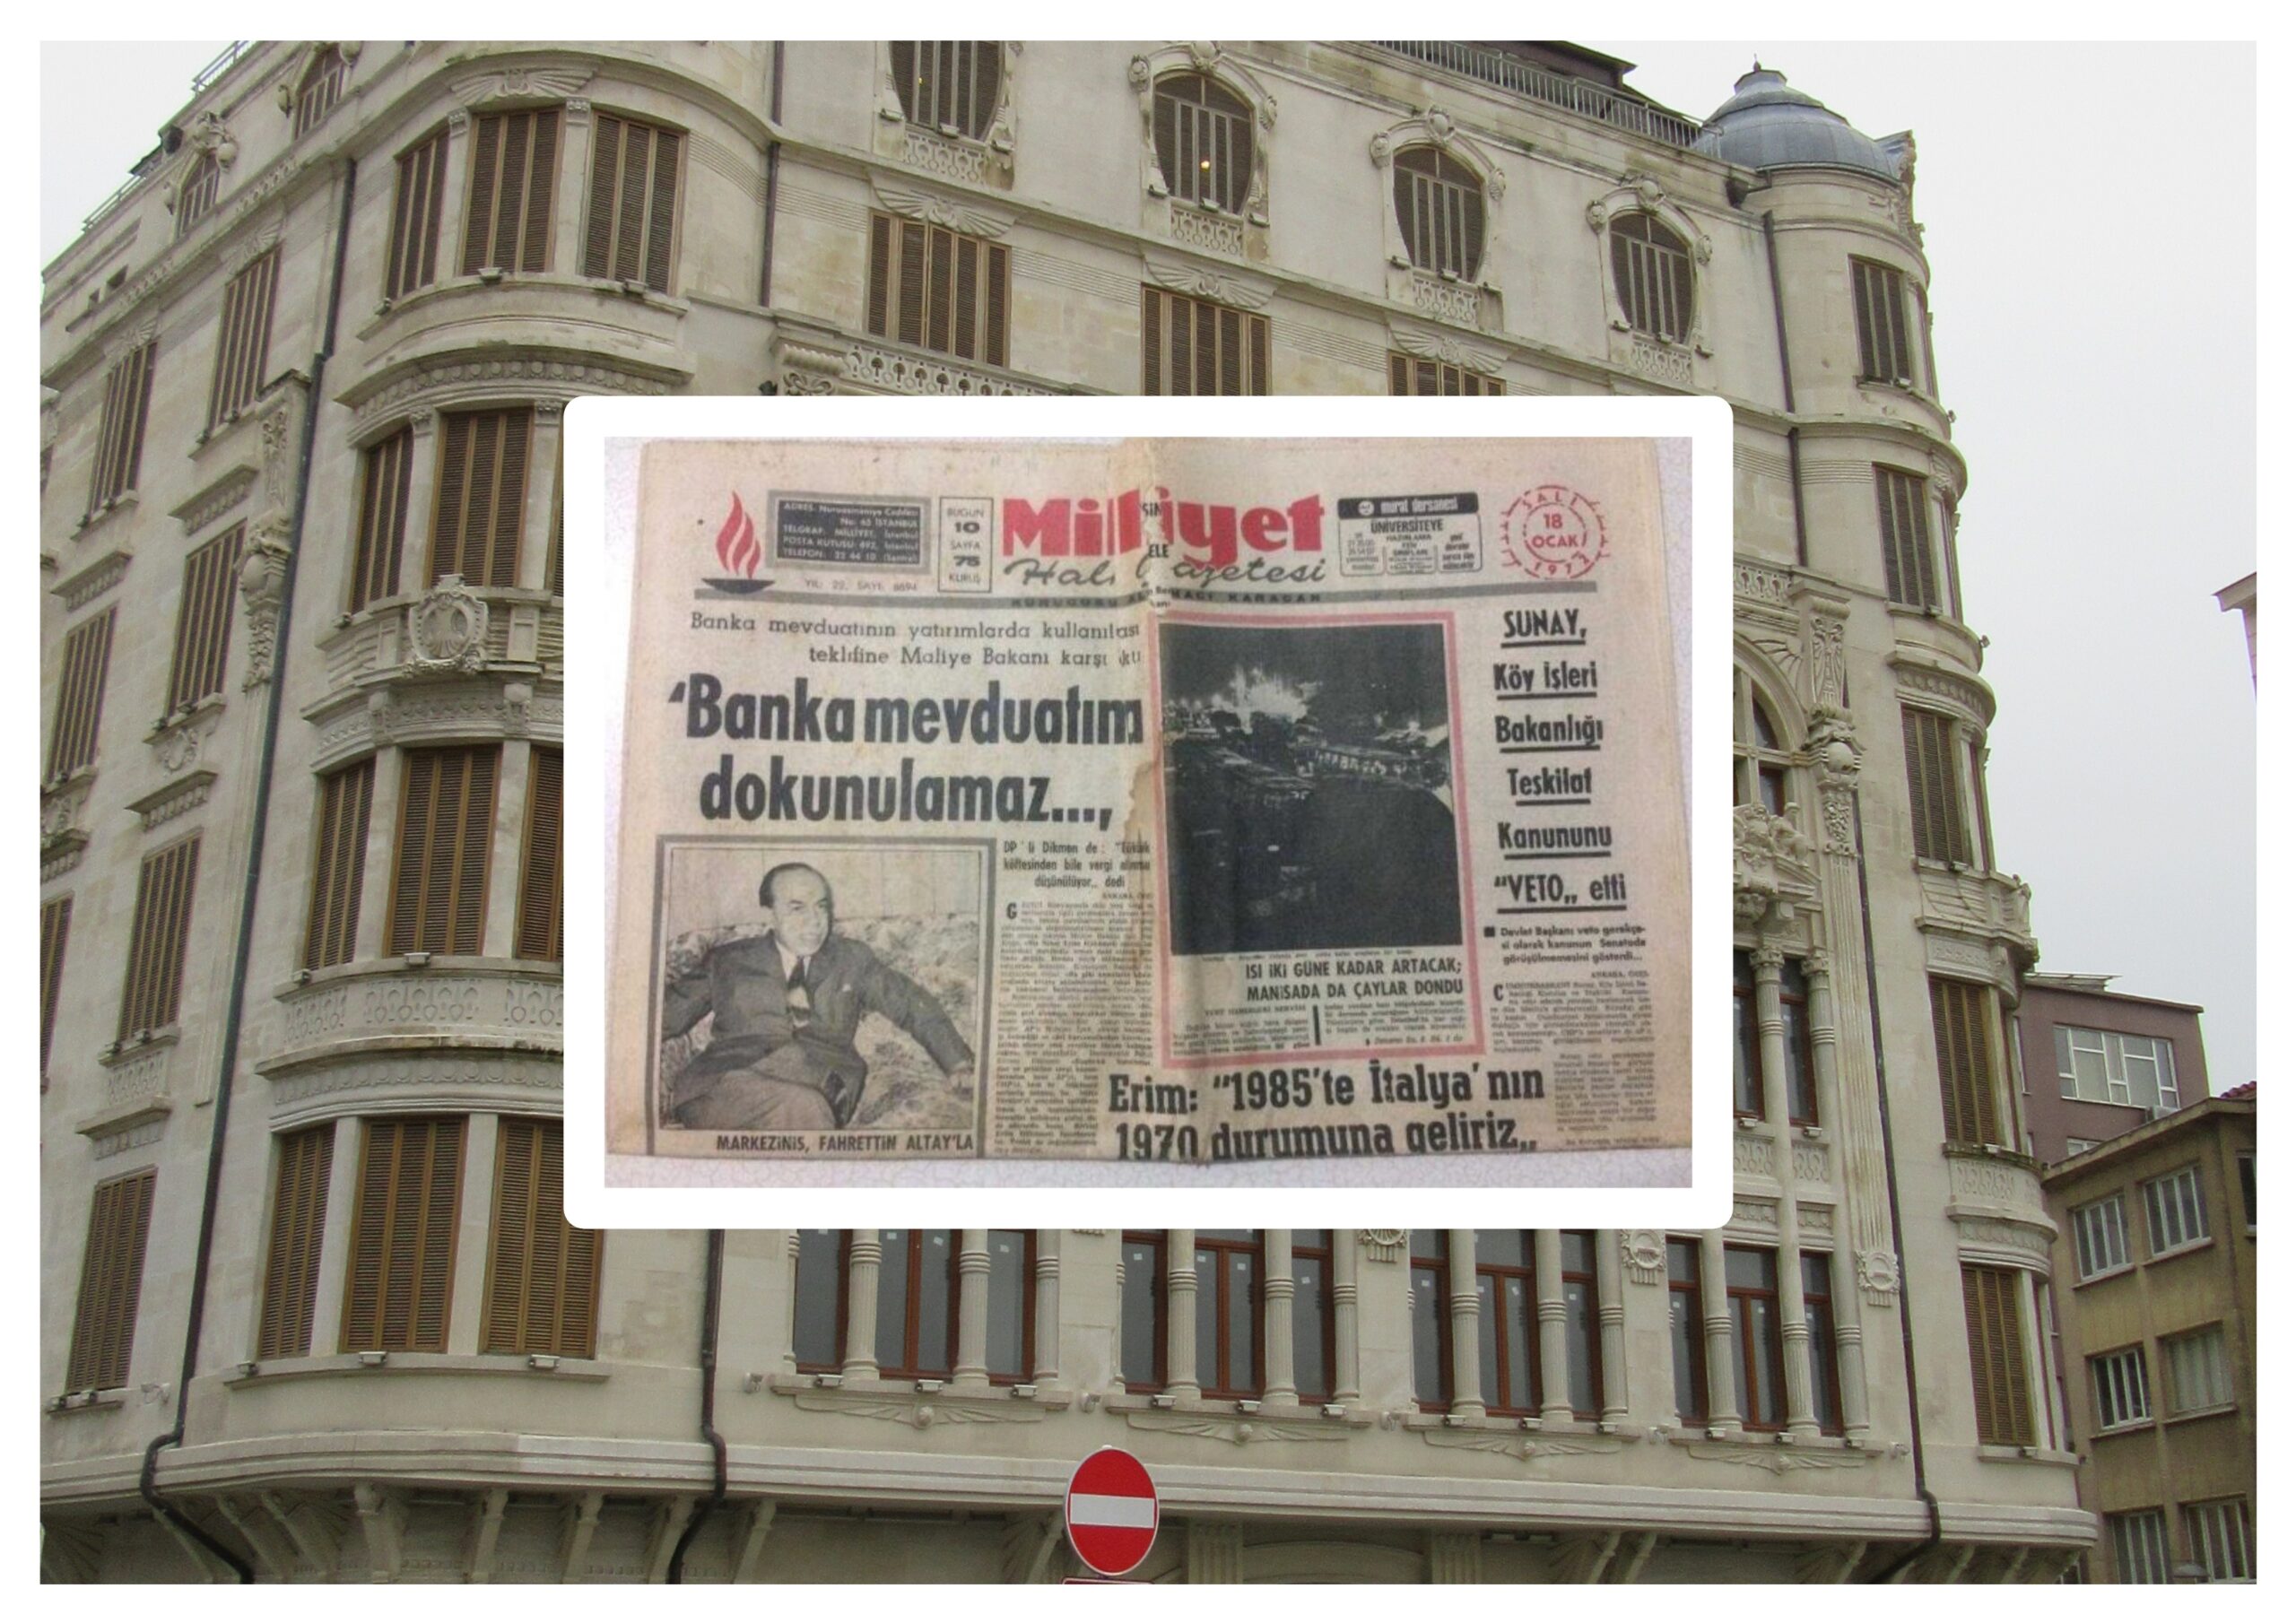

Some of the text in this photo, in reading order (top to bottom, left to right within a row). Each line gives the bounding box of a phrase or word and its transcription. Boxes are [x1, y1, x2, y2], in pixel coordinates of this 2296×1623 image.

[954, 522, 980, 534] 10
[1543, 513, 1563, 529] 18
[950, 542, 981, 551] SAYFA
[1531, 534, 1578, 549] OCAK
[953, 555, 981, 567] 75
[690, 612, 755, 633] Banka
[769, 618, 896, 638] mevduatının
[908, 621, 1031, 642] yatırımlarda
[1503, 607, 1587, 639] SUNAY,
[900, 647, 973, 670] Maliye
[982, 648, 1050, 666] Bakanı
[1493, 663, 1535, 691] Köy
[1495, 714, 1604, 746] Bakanlığı
[1497, 821, 1613, 849] Kanununu
[1064, 858, 1083, 870] bile
[1589, 872, 1628, 901] etti
[1500, 925, 1533, 936] Devlet
[1577, 925, 1600, 935] veto
[1547, 939, 1593, 950] kanunun
[1246, 963, 1263, 979] ISI
[1293, 959, 1331, 977] GÜNE
[1336, 959, 1385, 976] KADAR
[1391, 957, 1462, 974] ARTACAK;
[1327, 981, 1346, 999] DA
[1353, 979, 1407, 1000] ÇAYLAR
[1414, 977, 1464, 995] DONDU
[1108, 1072, 1198, 1115] Erim:
[818, 1134, 897, 1151] FAHRETTİN
[905, 1133, 973, 1150] ALTAY'LA
[1116, 1121, 1199, 1162] 1970
[1212, 1122, 1396, 1162] durumuna
